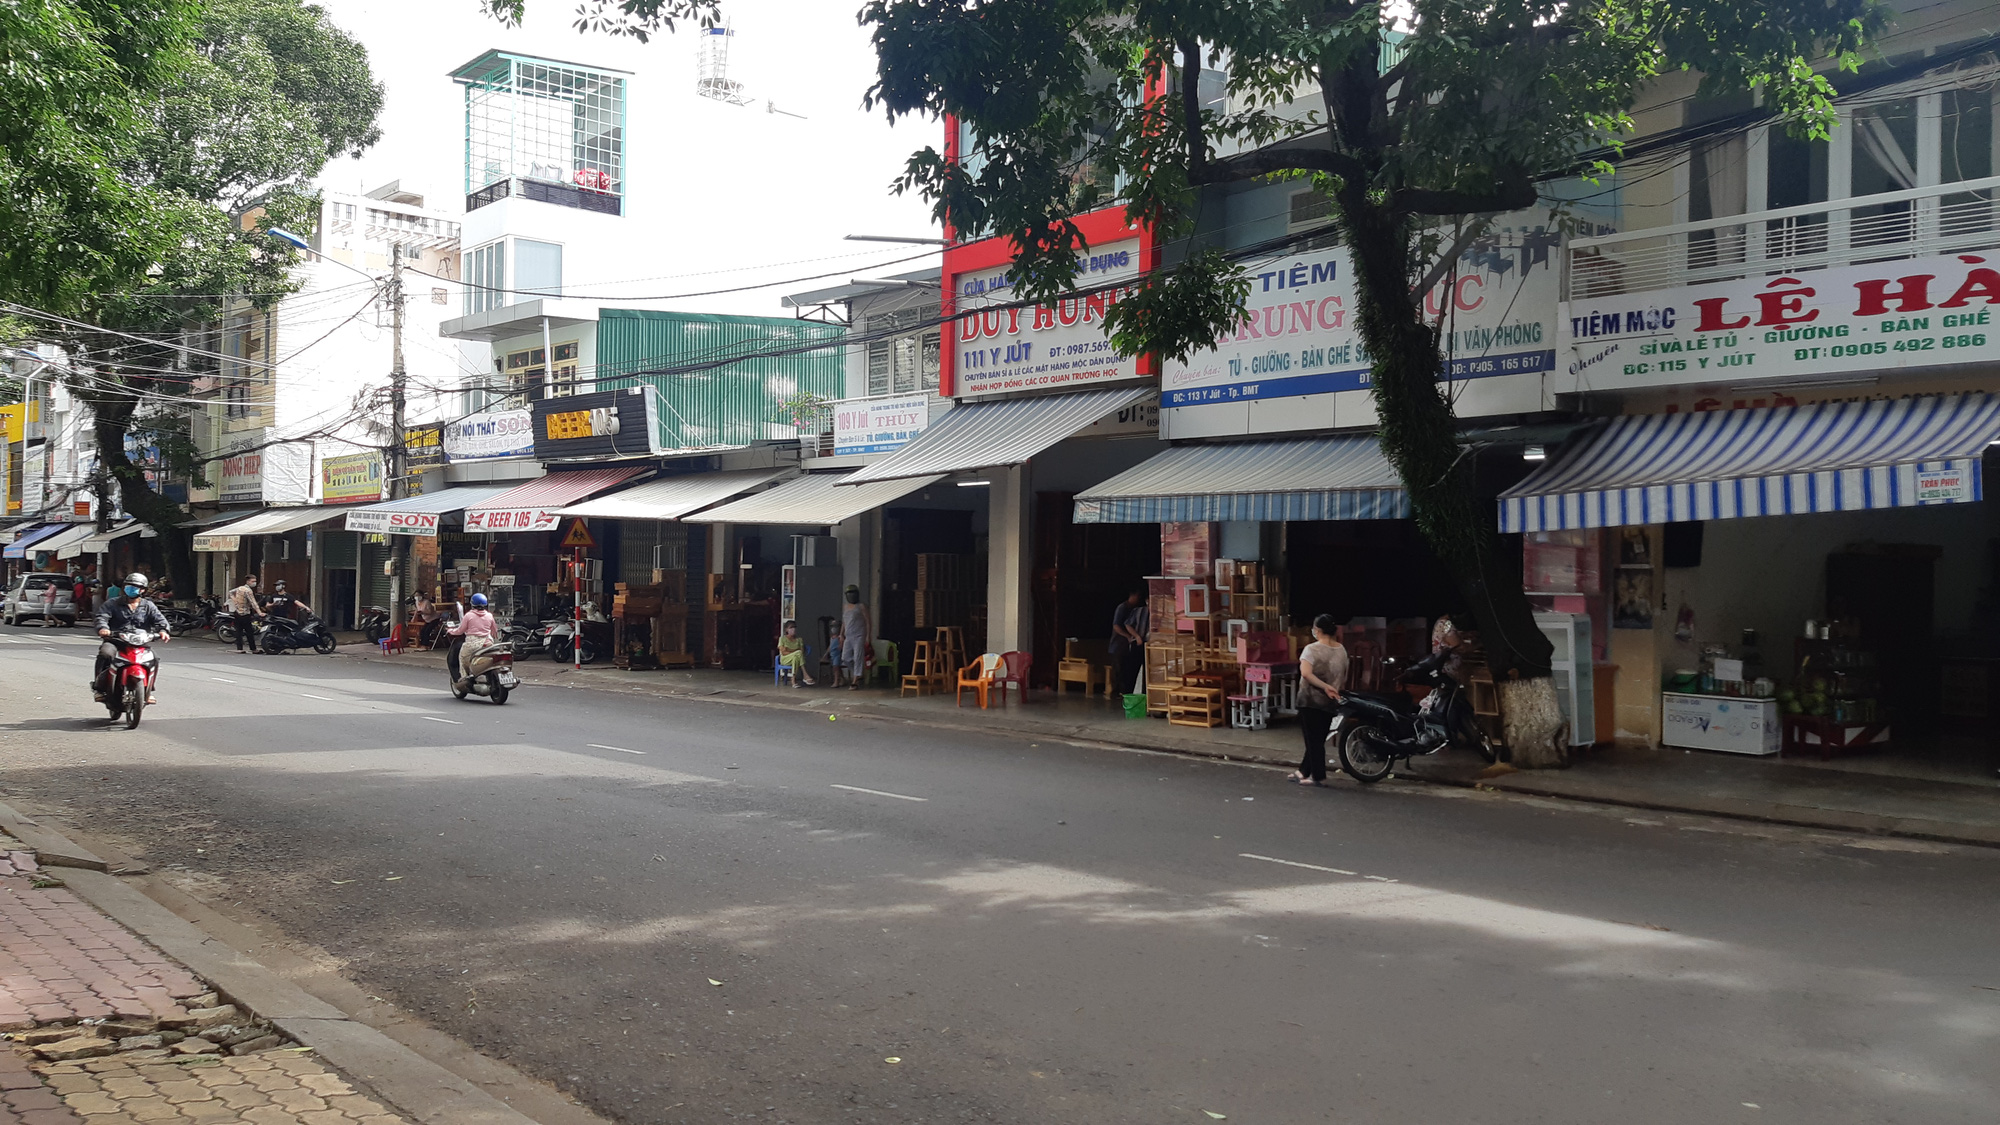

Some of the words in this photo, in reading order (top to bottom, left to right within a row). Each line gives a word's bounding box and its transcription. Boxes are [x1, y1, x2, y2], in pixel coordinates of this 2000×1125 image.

[1090, 251, 1129, 274] DỤNG
[1258, 261, 1336, 293] TIỆM
[1572, 310, 1620, 339] TIỆM
[1626, 305, 1675, 334] MỘC
[1692, 277, 1820, 331] LỆ
[1852, 255, 2000, 316] HÀ
[1660, 338, 1682, 353] VÀ
[1686, 334, 1707, 351] LẺ
[1713, 331, 1737, 348] TỦ
[1764, 325, 1849, 343] GIƯỜNG
[1881, 316, 1929, 333] BÀN
[1943, 306, 1990, 328] GHẾ
[964, 350, 985, 369] 111
[990, 347, 1001, 366] Y
[1173, 369, 1201, 384] Chuyên
[1203, 364, 1222, 377] bán:
[1229, 352, 1241, 377] TỦ
[1252, 349, 1290, 374] GIƯỜNG
[1302, 344, 1324, 369] BÀN
[1328, 338, 1351, 366] GHẾ
[1464, 325, 1490, 350] VĂN
[1496, 319, 1541, 347] PHÒNG
[1569, 344, 1620, 375] Chuyên
[1658, 360, 1686, 372] 115
[1698, 357, 1709, 369] Y
[1717, 351, 1755, 367] JÚT
[1831, 341, 1887, 358] 0905
[1893, 337, 1935, 352] 492
[1942, 333, 1986, 349] 886
[965, 371, 987, 381] CHUYÊN
[988, 370, 1000, 379] BÁN
[1022, 365, 1034, 374] CÁC
[1035, 363, 1049, 374] MẶT
[1050, 360, 1070, 371] HÀNG
[1072, 358, 1087, 369] MỘC
[1089, 357, 1104, 366] DÂN
[1106, 355, 1127, 366] DỤNG
[970, 383, 988, 392] NHẬN
[989, 381, 1003, 391] HỢP
[1025, 376, 1037, 386] CÁC
[1039, 375, 1049, 384] CƠ
[1050, 373, 1070, 383] QUAN
[1072, 369, 1101, 380] TRƯỜNG
[1103, 367, 1118, 378] HỌC
[1173, 393, 1185, 402] ĐC:
[1188, 392, 1200, 401] 113
[1203, 390, 1208, 399] Y
[1209, 388, 1220, 398] Jút
[1229, 387, 1239, 398] Tp.
[1243, 385, 1259, 395] BMT
[1502, 358, 1518, 369] 165
[1522, 356, 1540, 368] 617
[462, 421, 474, 440] NỘI
[477, 416, 496, 435] THẤT
[497, 414, 532, 433] SƠN
[546, 410, 592, 439] BEER
[838, 412, 850, 430] 109
[852, 411, 856, 429] Y
[858, 410, 868, 428] Jút
[875, 410, 919, 427] THỦY
[390, 513, 436, 527] SƠN
[488, 512, 511, 527] BEER
[514, 511, 532, 527] 105
